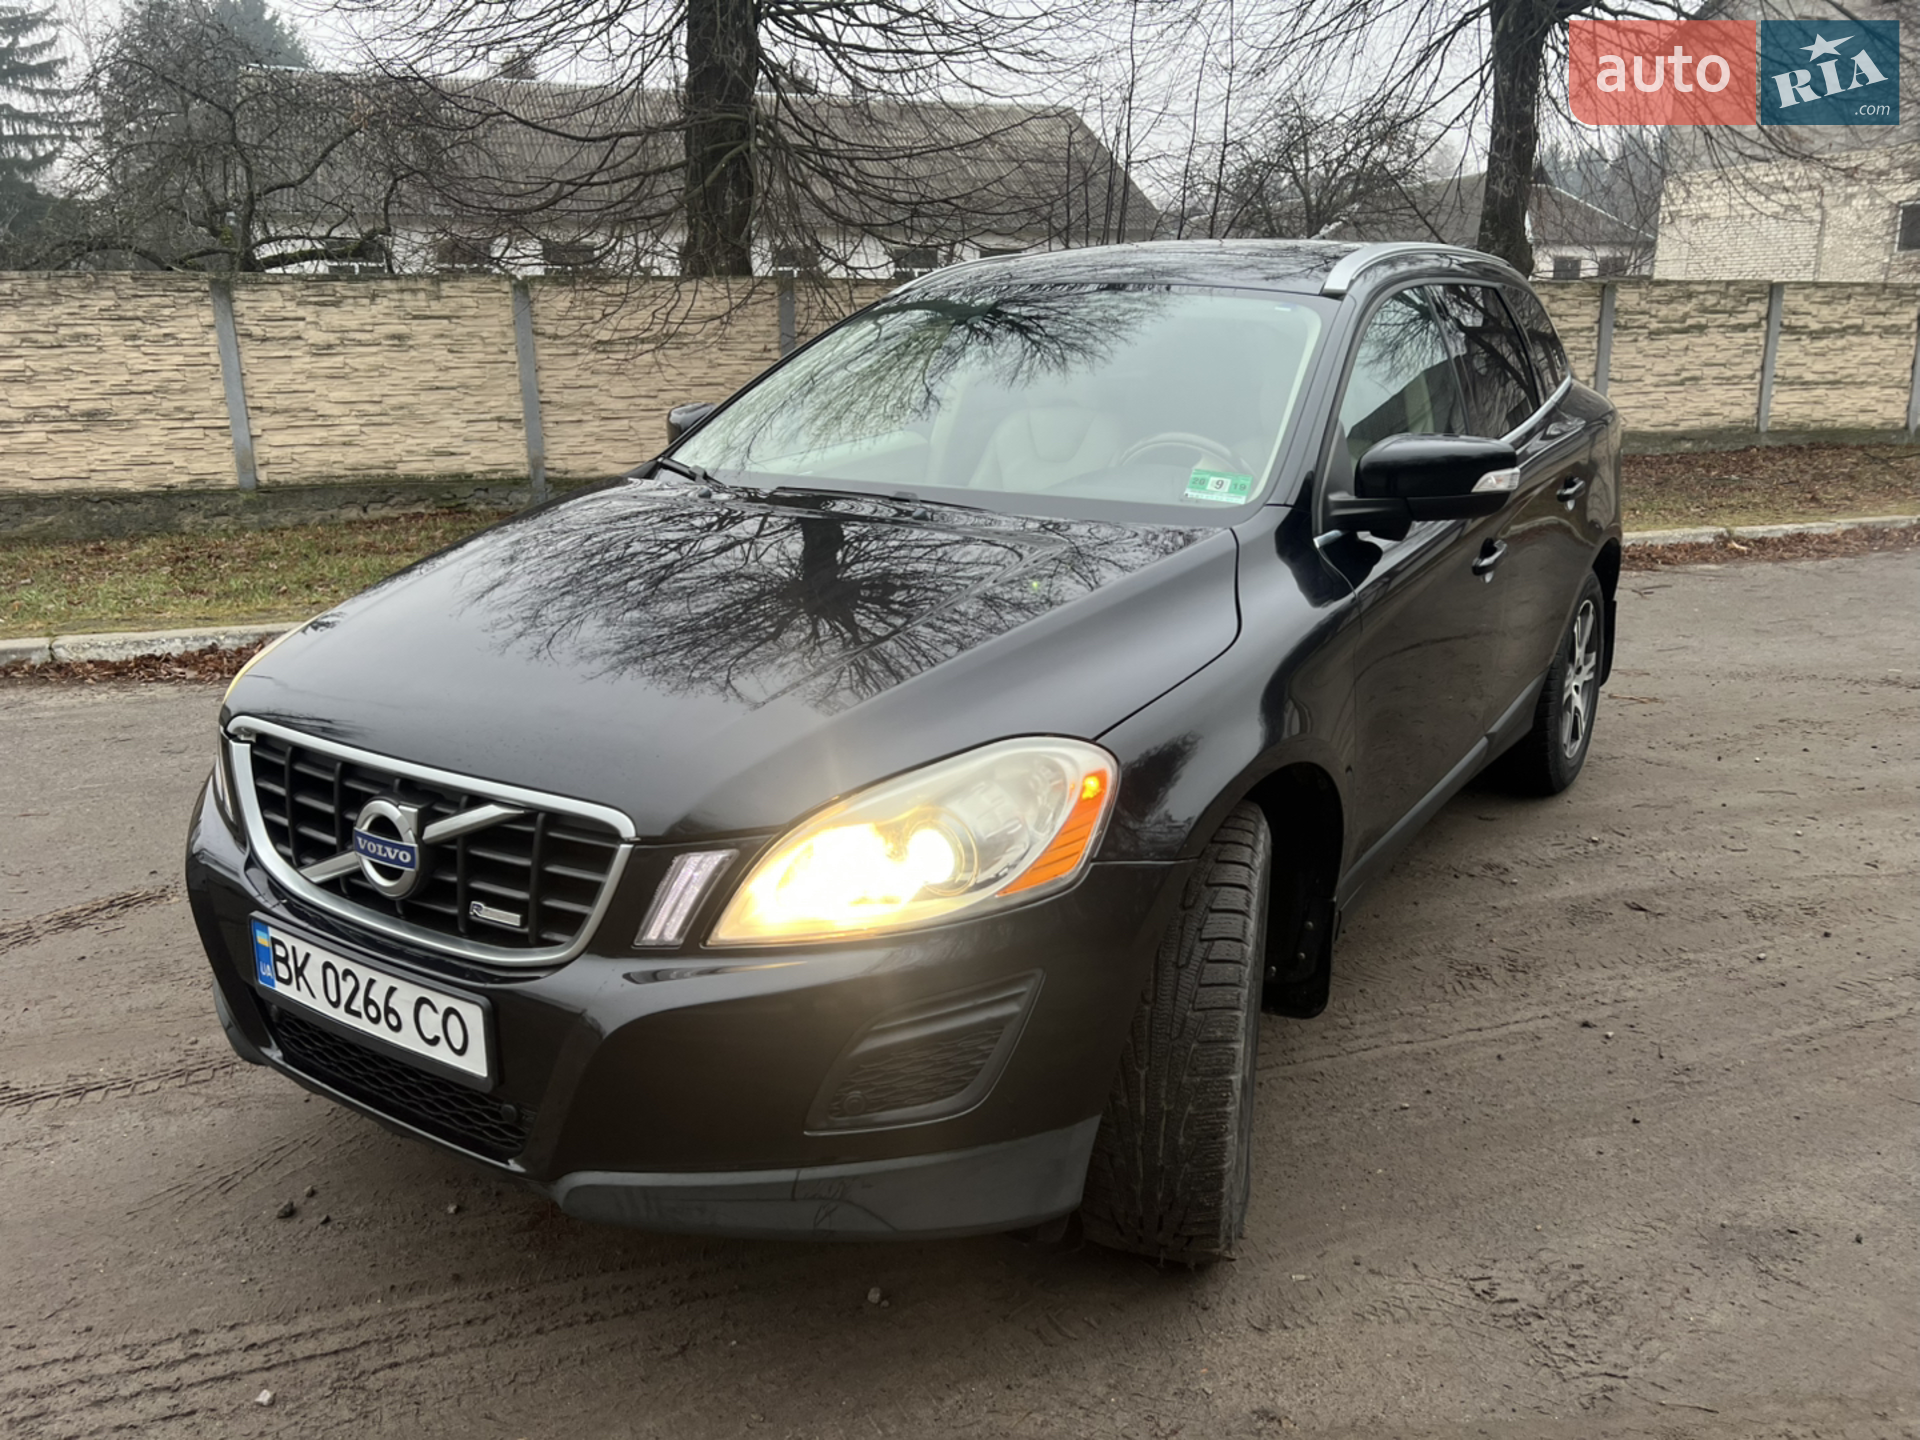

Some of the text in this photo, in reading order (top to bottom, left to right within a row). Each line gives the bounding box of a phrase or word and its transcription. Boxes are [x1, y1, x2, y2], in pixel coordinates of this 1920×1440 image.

[1192, 477, 1247, 491] 20 9 19
[357, 837, 411, 863] VOLVO
[260, 961, 272, 977] UA
[271, 936, 469, 1057] BK 0266 CO
